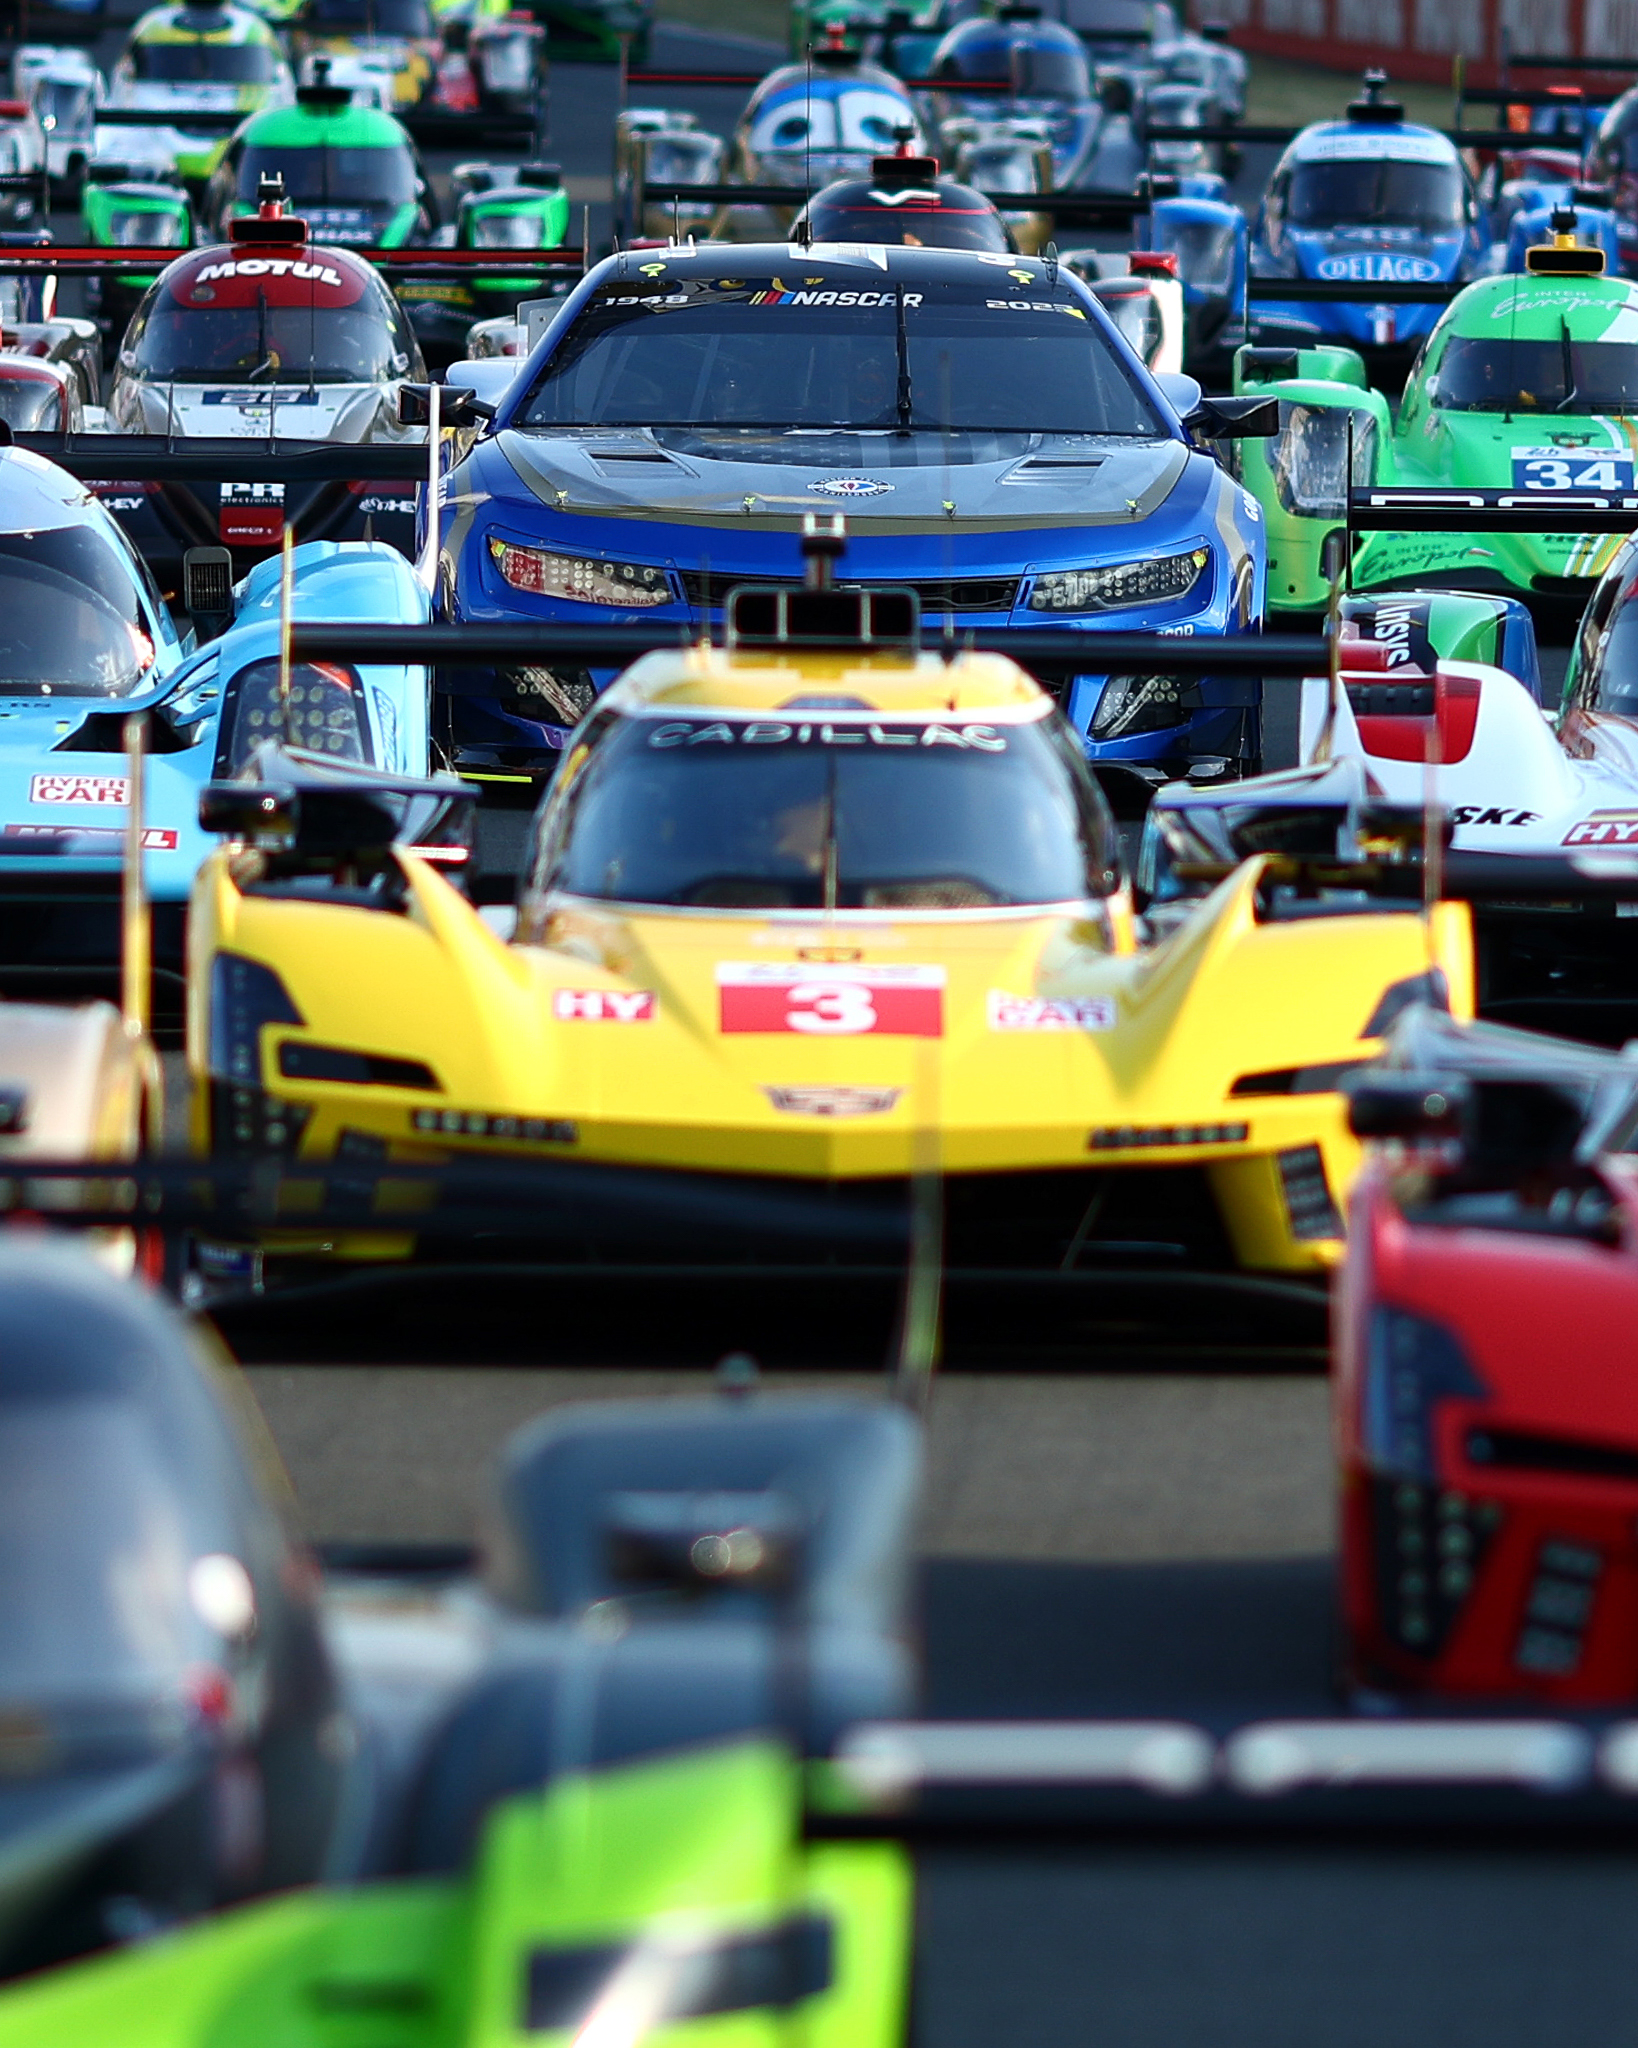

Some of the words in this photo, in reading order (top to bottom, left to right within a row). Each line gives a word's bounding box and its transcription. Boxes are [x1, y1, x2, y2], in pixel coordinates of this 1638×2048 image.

[196, 259, 342, 286] MOTUL
[1331, 256, 1426, 281] DELAGE
[606, 295, 689, 306] 1948
[791, 291, 923, 307] NASCAR
[1525, 461, 1622, 490] 34
[220, 482, 285, 497] PR
[650, 722, 1007, 751] CADILLAC
[40, 777, 125, 787] HYPER
[39, 787, 124, 802] CAR
[1450, 806, 1543, 826] SKE
[558, 991, 648, 1022] HY
[786, 983, 878, 1034] 3
